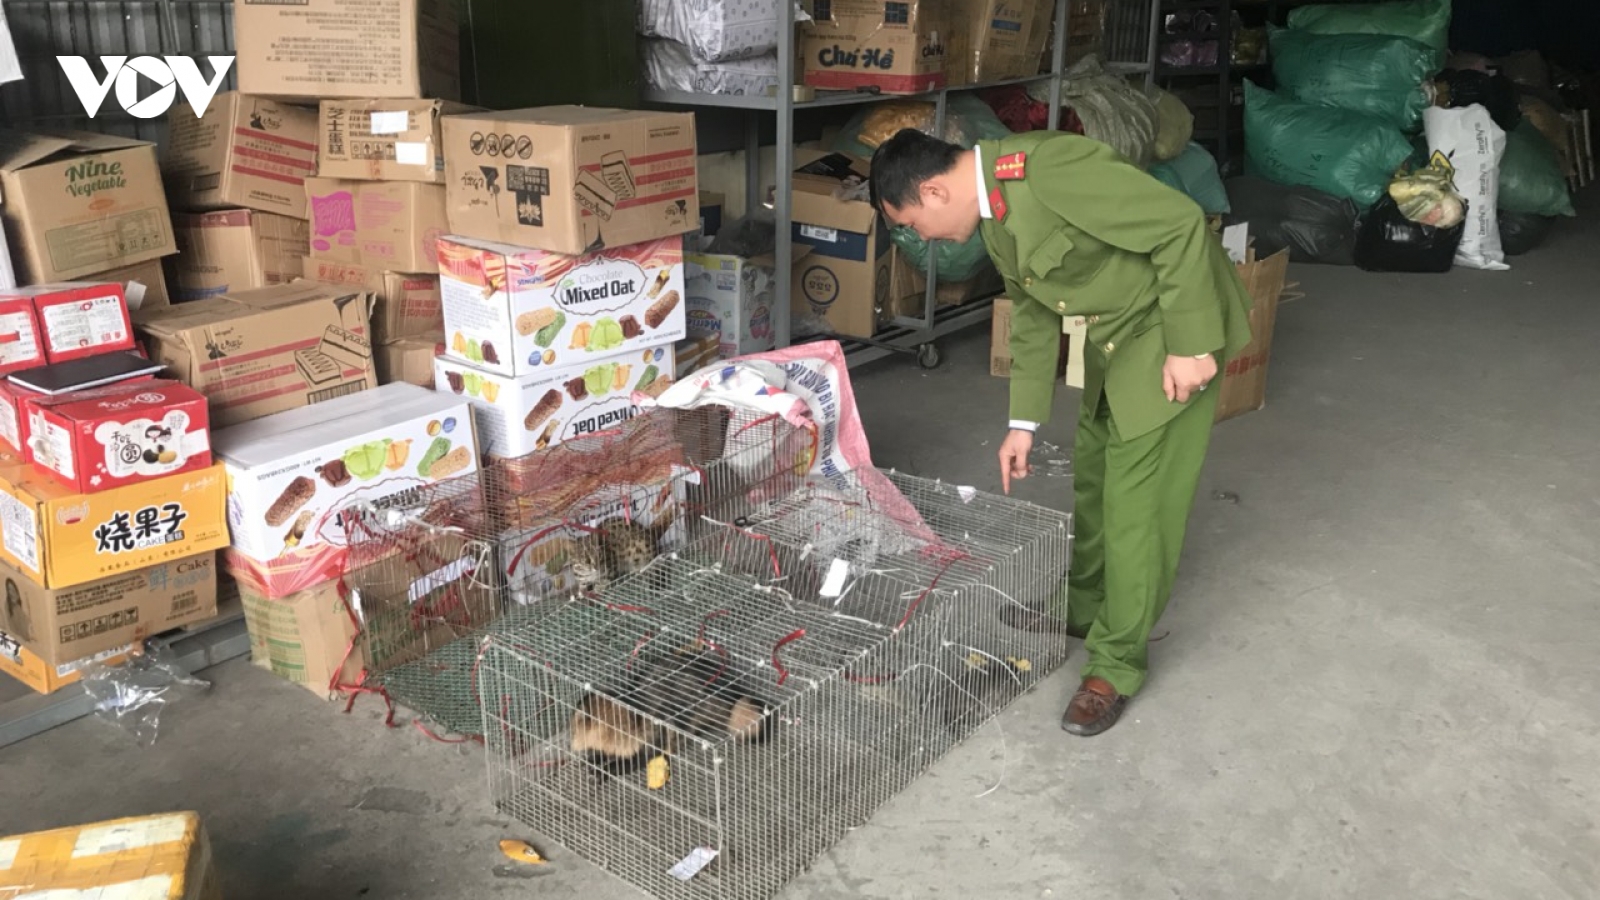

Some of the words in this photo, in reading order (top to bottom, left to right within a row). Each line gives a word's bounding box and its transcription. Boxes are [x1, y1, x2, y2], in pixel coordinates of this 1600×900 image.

[819, 44, 860, 67] Chú
[861, 48, 894, 70] Hề
[326, 107, 345, 154] 芝士蛋糕
[65, 160, 124, 182] Nine
[66, 176, 127, 197] Vegetable
[578, 268, 623, 285] Chocolate
[563, 282, 608, 306] Mixed
[611, 279, 635, 297] Oat
[572, 417, 596, 436] Oat
[95, 503, 186, 552] 烧果子
[138, 536, 164, 548] CAKE
[177, 558, 210, 574] Cake
